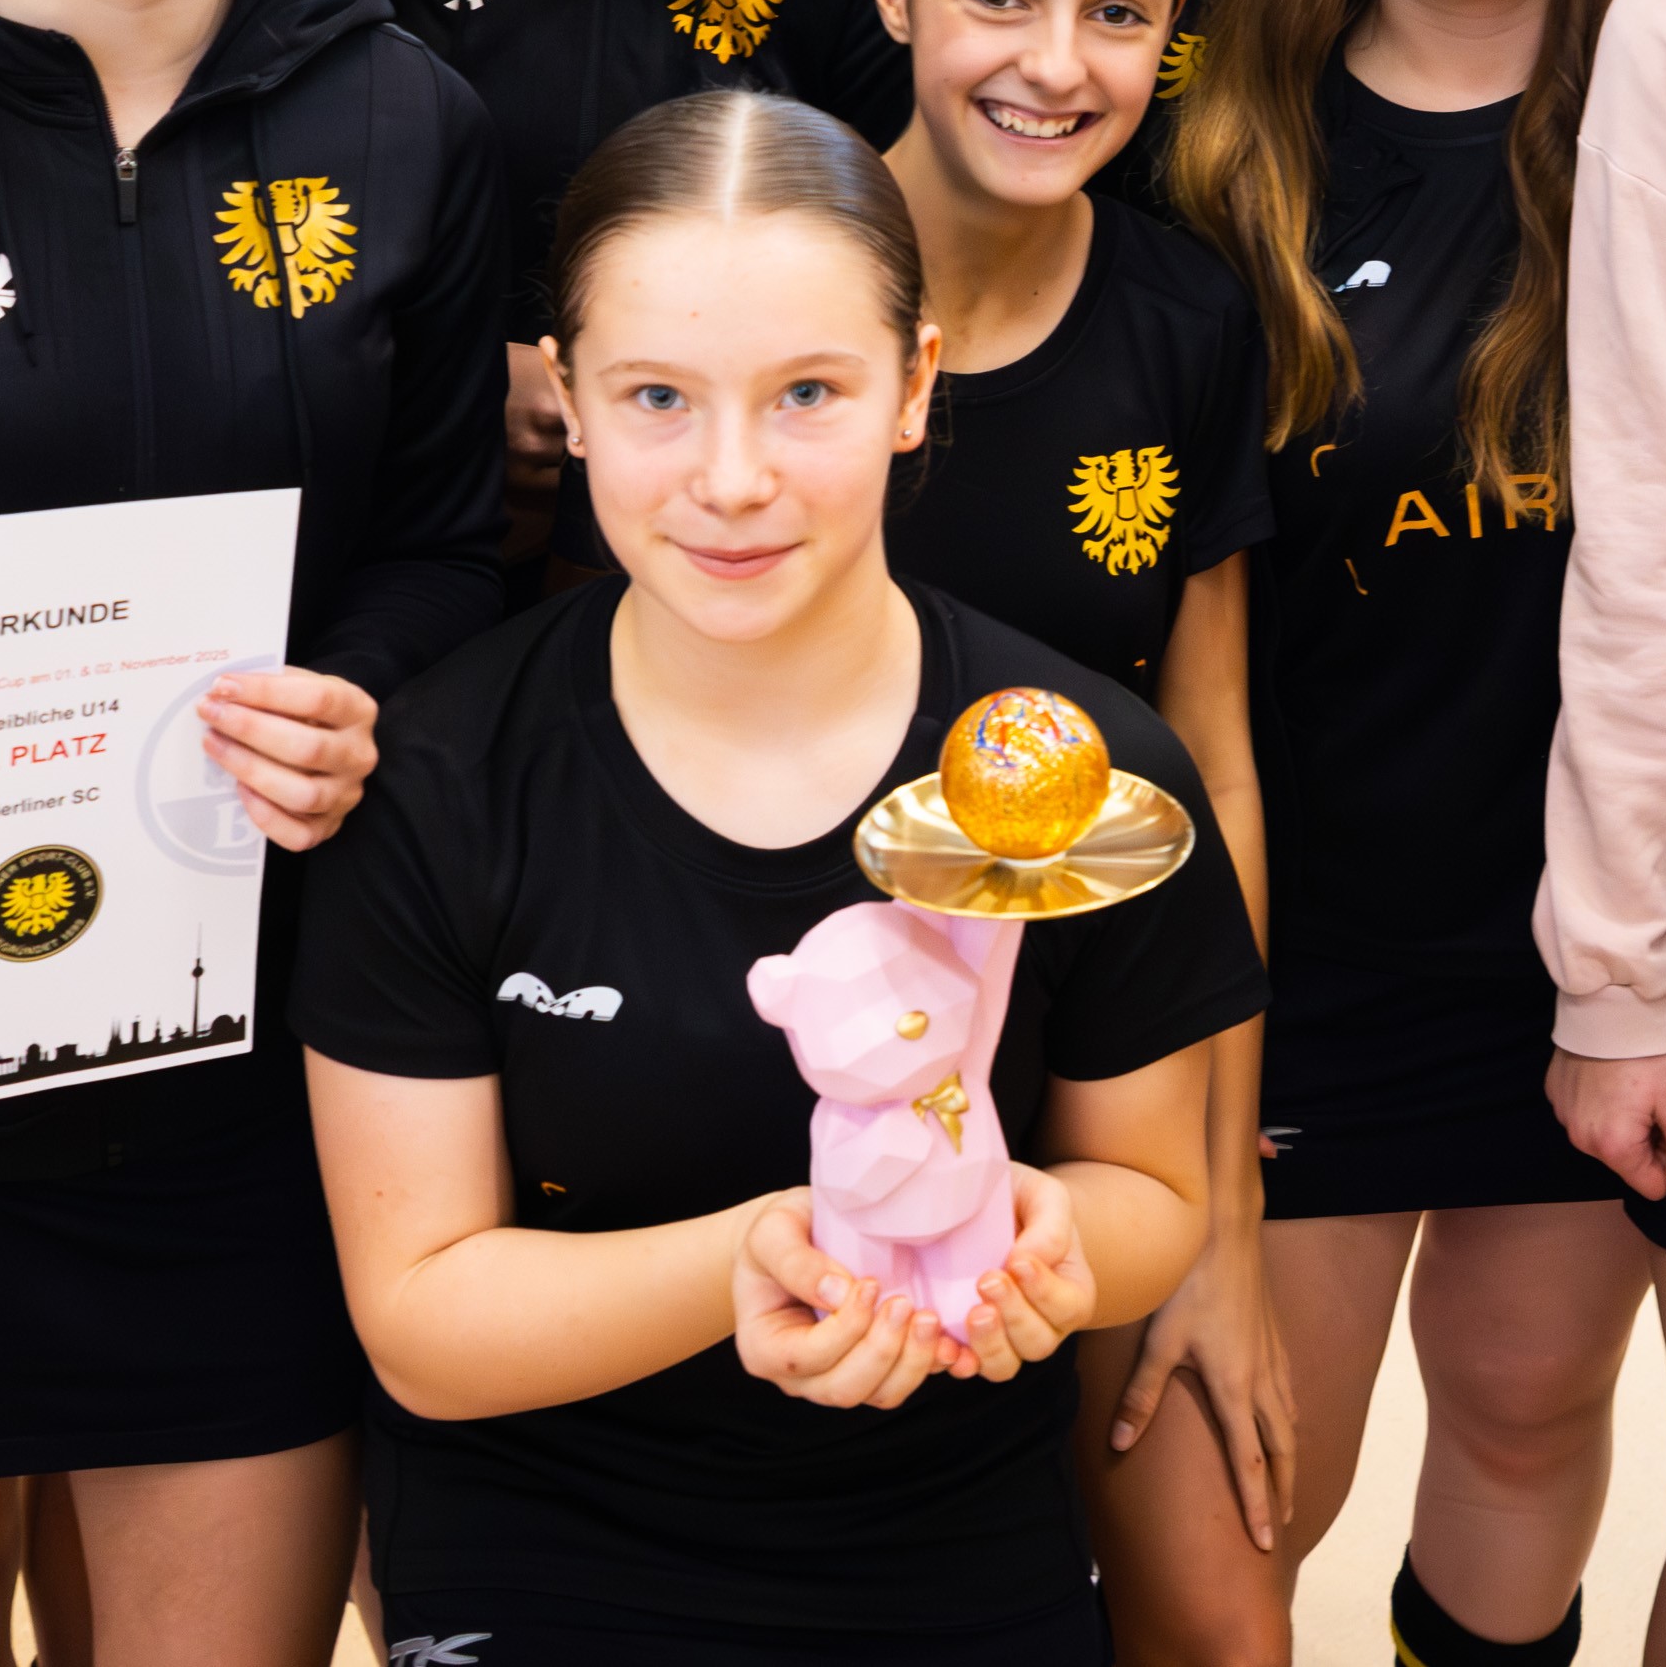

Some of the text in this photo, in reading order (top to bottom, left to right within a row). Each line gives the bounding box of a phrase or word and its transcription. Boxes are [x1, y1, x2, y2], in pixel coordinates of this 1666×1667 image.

[119, 653, 191, 670] November
[81, 698, 120, 718] U14
[10, 732, 109, 767] PLATZ
[71, 786, 101, 806] SC
